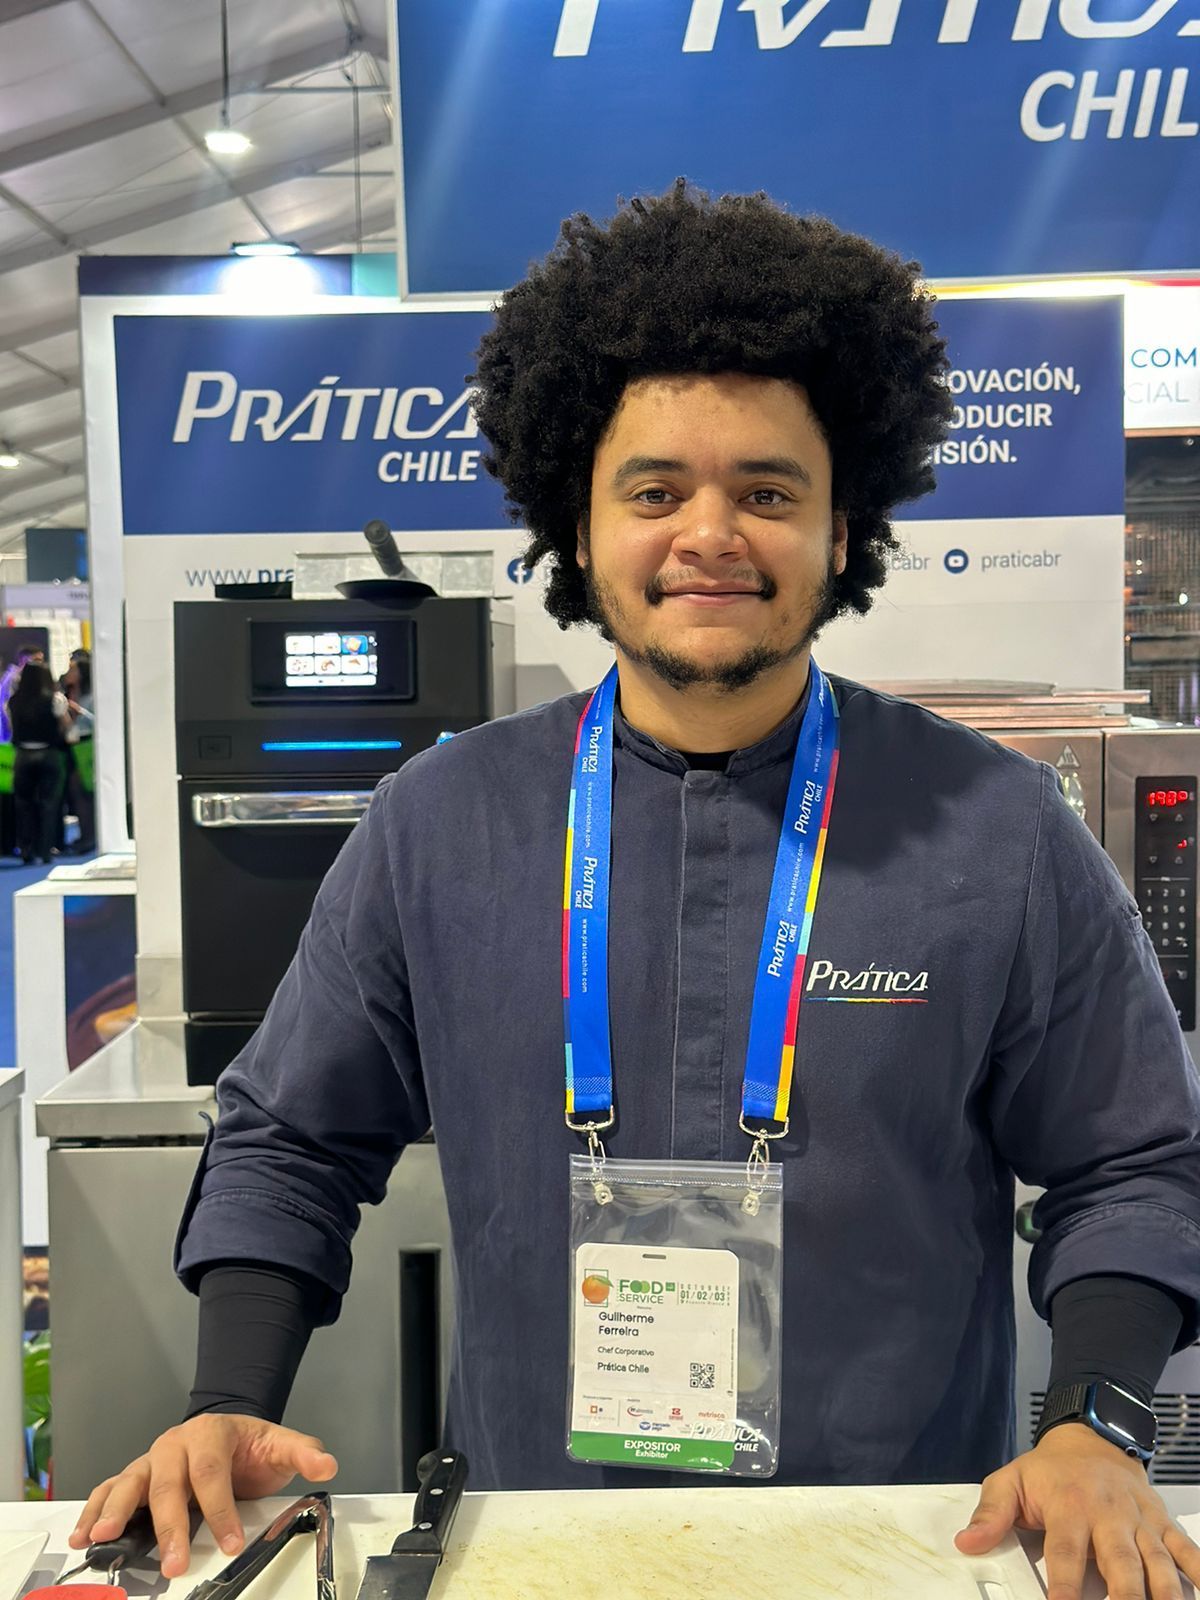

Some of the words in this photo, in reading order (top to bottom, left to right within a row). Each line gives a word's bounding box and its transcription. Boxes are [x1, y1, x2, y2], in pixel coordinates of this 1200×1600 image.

[1020, 68, 1199, 142] CHIL
[1130, 347, 1197, 369] COM
[942, 361, 1081, 396] OVACIÓN,
[172, 370, 479, 443] PRÁTICA
[932, 434, 1018, 465] ISIÓN.
[377, 450, 481, 483] CHILE
[980, 550, 1062, 572] praticabr
[588, 725, 603, 773] PRÁTICA
[814, 785, 823, 802] CHILE
[794, 779, 816, 835] PRÁTICA
[582, 856, 598, 910] PRÁTICA
[574, 890, 582, 908] CHILE
[788, 924, 798, 943] CHILE
[767, 919, 790, 978] PRÁTICA
[805, 960, 929, 992] PRÁTICA
[619, 1293, 664, 1304] SERVICE
[598, 1311, 655, 1324] Guilherme
[598, 1325, 640, 1337] Ferreira
[597, 1346, 614, 1354] Chef
[615, 1347, 655, 1357] Corporativo
[597, 1362, 627, 1373] Prática
[628, 1364, 650, 1374] Chile
[623, 1439, 682, 1453] EXPOSITOR
[635, 1450, 669, 1459] Exhibitor
[734, 1442, 759, 1453] CHILE
